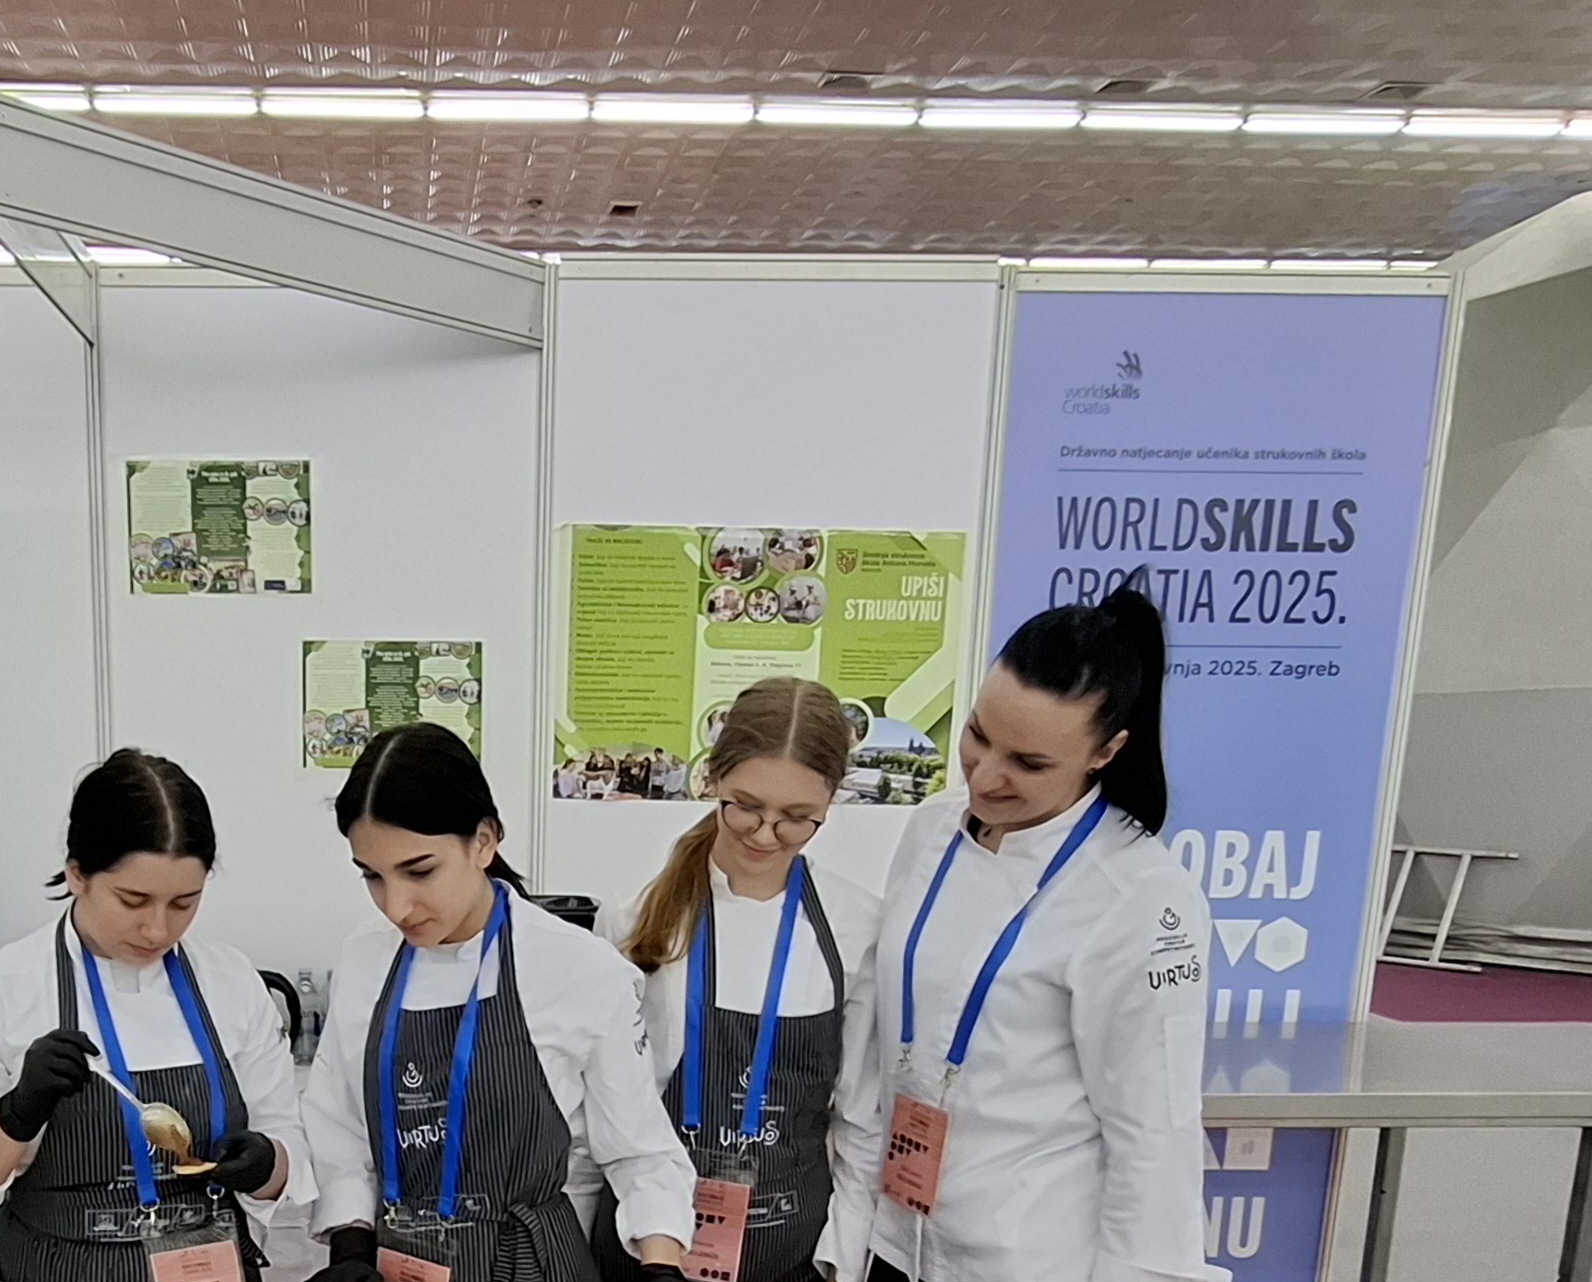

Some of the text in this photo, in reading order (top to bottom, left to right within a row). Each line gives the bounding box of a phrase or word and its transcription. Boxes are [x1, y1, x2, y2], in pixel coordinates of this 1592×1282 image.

[1064, 383, 1140, 400] worldskills
[1062, 399, 1111, 415] Croatia
[1059, 445, 1367, 461] Državno natjecanje učenika strukovnih škola
[1057, 496, 1358, 554] WORLDSKILLS
[901, 572, 945, 598] UPIŠI
[1228, 569, 1347, 625] 2025.
[844, 598, 943, 622] STRUKOVNU
[1208, 660, 1263, 676] 2025.
[1269, 660, 1341, 679] Zagreb
